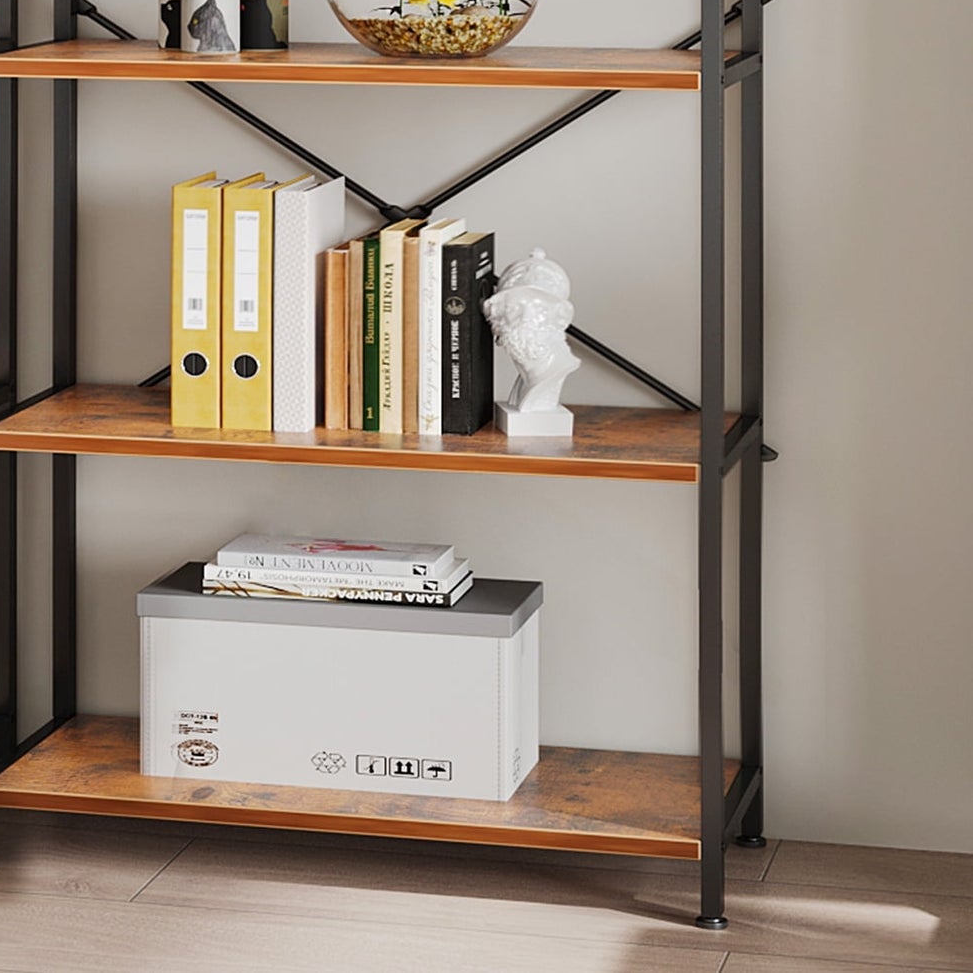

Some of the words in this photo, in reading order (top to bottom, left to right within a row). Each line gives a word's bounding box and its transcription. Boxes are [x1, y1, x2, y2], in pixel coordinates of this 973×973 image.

[365, 248, 375, 290] Бианки
[383, 263, 394, 313] ШКОЛА
[365, 293, 375, 344] Виталий
[301, 587, 403, 603] PENNYPACKER
[405, 593, 444, 604] SARA
